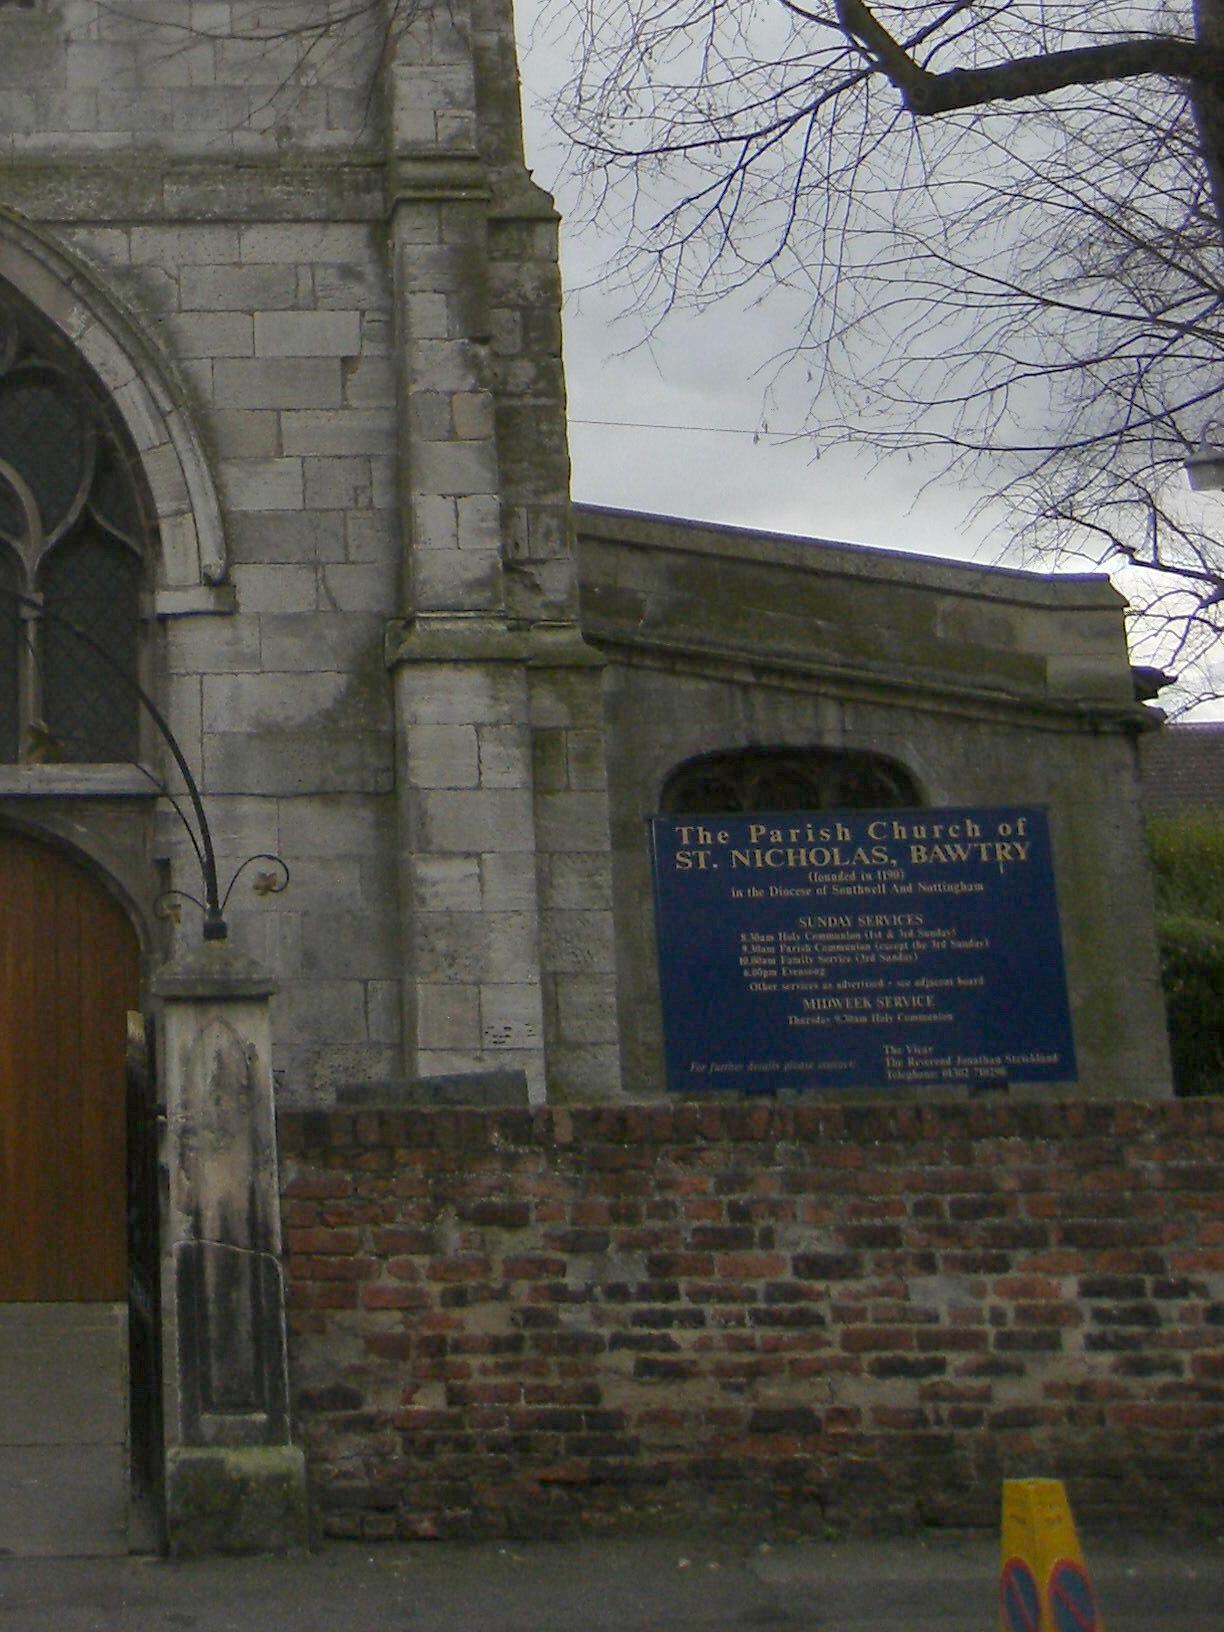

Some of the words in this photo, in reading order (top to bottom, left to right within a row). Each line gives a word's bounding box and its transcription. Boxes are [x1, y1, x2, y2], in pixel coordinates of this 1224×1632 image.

[673, 825, 730, 846] The
[749, 821, 852, 845] Parish
[867, 818, 981, 841] Church
[997, 816, 1027, 838] of
[675, 849, 718, 870] ST.
[730, 844, 898, 869] NICHOLAS,
[909, 840, 1031, 865] BAWTRY
[860, 869, 873, 882] in
[730, 886, 743, 898] in
[747, 884, 765, 898] the
[768, 884, 811, 898] Diocese
[816, 884, 827, 896] of
[831, 881, 886, 896] Southwell
[917, 879, 985, 895] Nottingham
[798, 914, 852, 929] SUNDAY
[858, 912, 924, 928] SERVICES
[778, 930, 801, 943] Holy
[804, 929, 861, 942] Communion
[779, 942, 812, 954] Parish
[814, 941, 872, 954] Communion
[780, 953, 814, 967] Family
[802, 996, 873, 1010] MIDWEEK
[876, 993, 935, 1009] SERVICE
[896, 1010, 954, 1024] Communion
